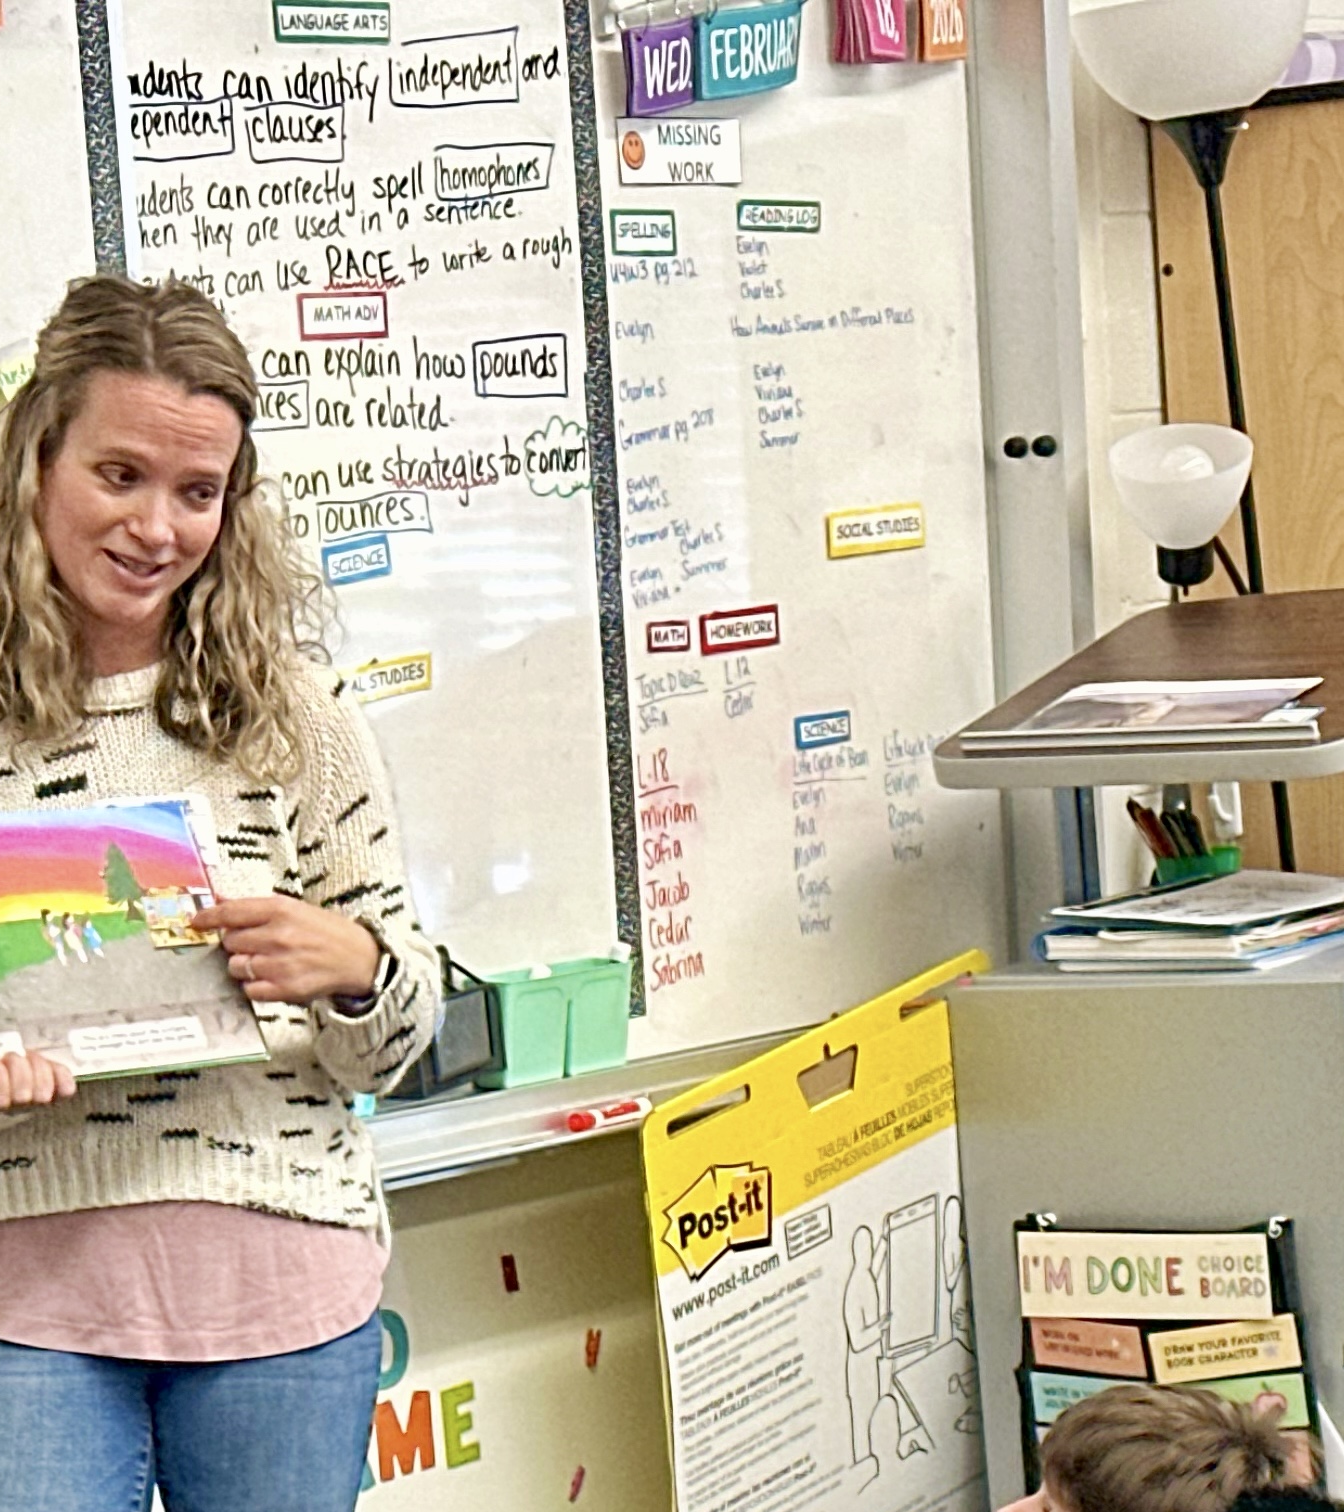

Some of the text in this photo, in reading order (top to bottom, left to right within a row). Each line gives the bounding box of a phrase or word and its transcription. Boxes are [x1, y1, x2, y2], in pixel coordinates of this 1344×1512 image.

[281, 13, 389, 32] LANGUAGE ARTS
[710, 17, 798, 80] FEBRUAR
[644, 36, 693, 99] WED.
[223, 70, 273, 104] can
[286, 59, 380, 123] identify
[399, 45, 512, 101] independent
[522, 46, 561, 80] and
[658, 124, 722, 146] MISSING
[207, 182, 252, 211] can
[258, 168, 355, 217] correctly
[373, 162, 424, 200] spell
[439, 153, 540, 194] homophones
[667, 162, 715, 182] WORK
[192, 218, 232, 258] they
[247, 218, 278, 243] are
[296, 210, 340, 240] used
[361, 206, 381, 233] in
[397, 209, 410, 231] a
[424, 197, 523, 223] sentence.
[745, 207, 818, 224] READING LOG
[618, 223, 672, 238] SPELLING
[225, 268, 264, 299] can
[277, 260, 311, 291] use
[327, 245, 394, 285] RACE
[409, 245, 429, 282] to
[442, 239, 491, 271] write
[503, 242, 517, 260] a
[522, 226, 572, 269] rough
[672, 257, 697, 277] 212
[313, 304, 378, 322] MATH ADV
[262, 336, 558, 398] can explain how pounds
[316, 388, 456, 430] are related.
[283, 436, 586, 507] can use strategies to convert
[325, 495, 426, 534] ounces.
[836, 517, 920, 540] SOCIAL STUDIES
[331, 547, 385, 576] SCIENCE
[654, 627, 686, 644] MATH
[710, 621, 774, 640] HOMEWORK
[370, 664, 425, 689] STUDIES
[803, 719, 846, 738] SCIENCE
[645, 874, 690, 910] Jacob
[648, 915, 692, 950] Cedar
[650, 951, 705, 992] Sabrina
[672, 1253, 780, 1321] www.post-it.com
[1023, 1255, 1265, 1297] I'M DONE CHOICE
[1200, 1278, 1267, 1298] BOARD
[1198, 1339, 1229, 1352] YOUR
[1230, 1330, 1282, 1347] FAVORITE
[1167, 1348, 1258, 1370] BOOK CHARACTER
